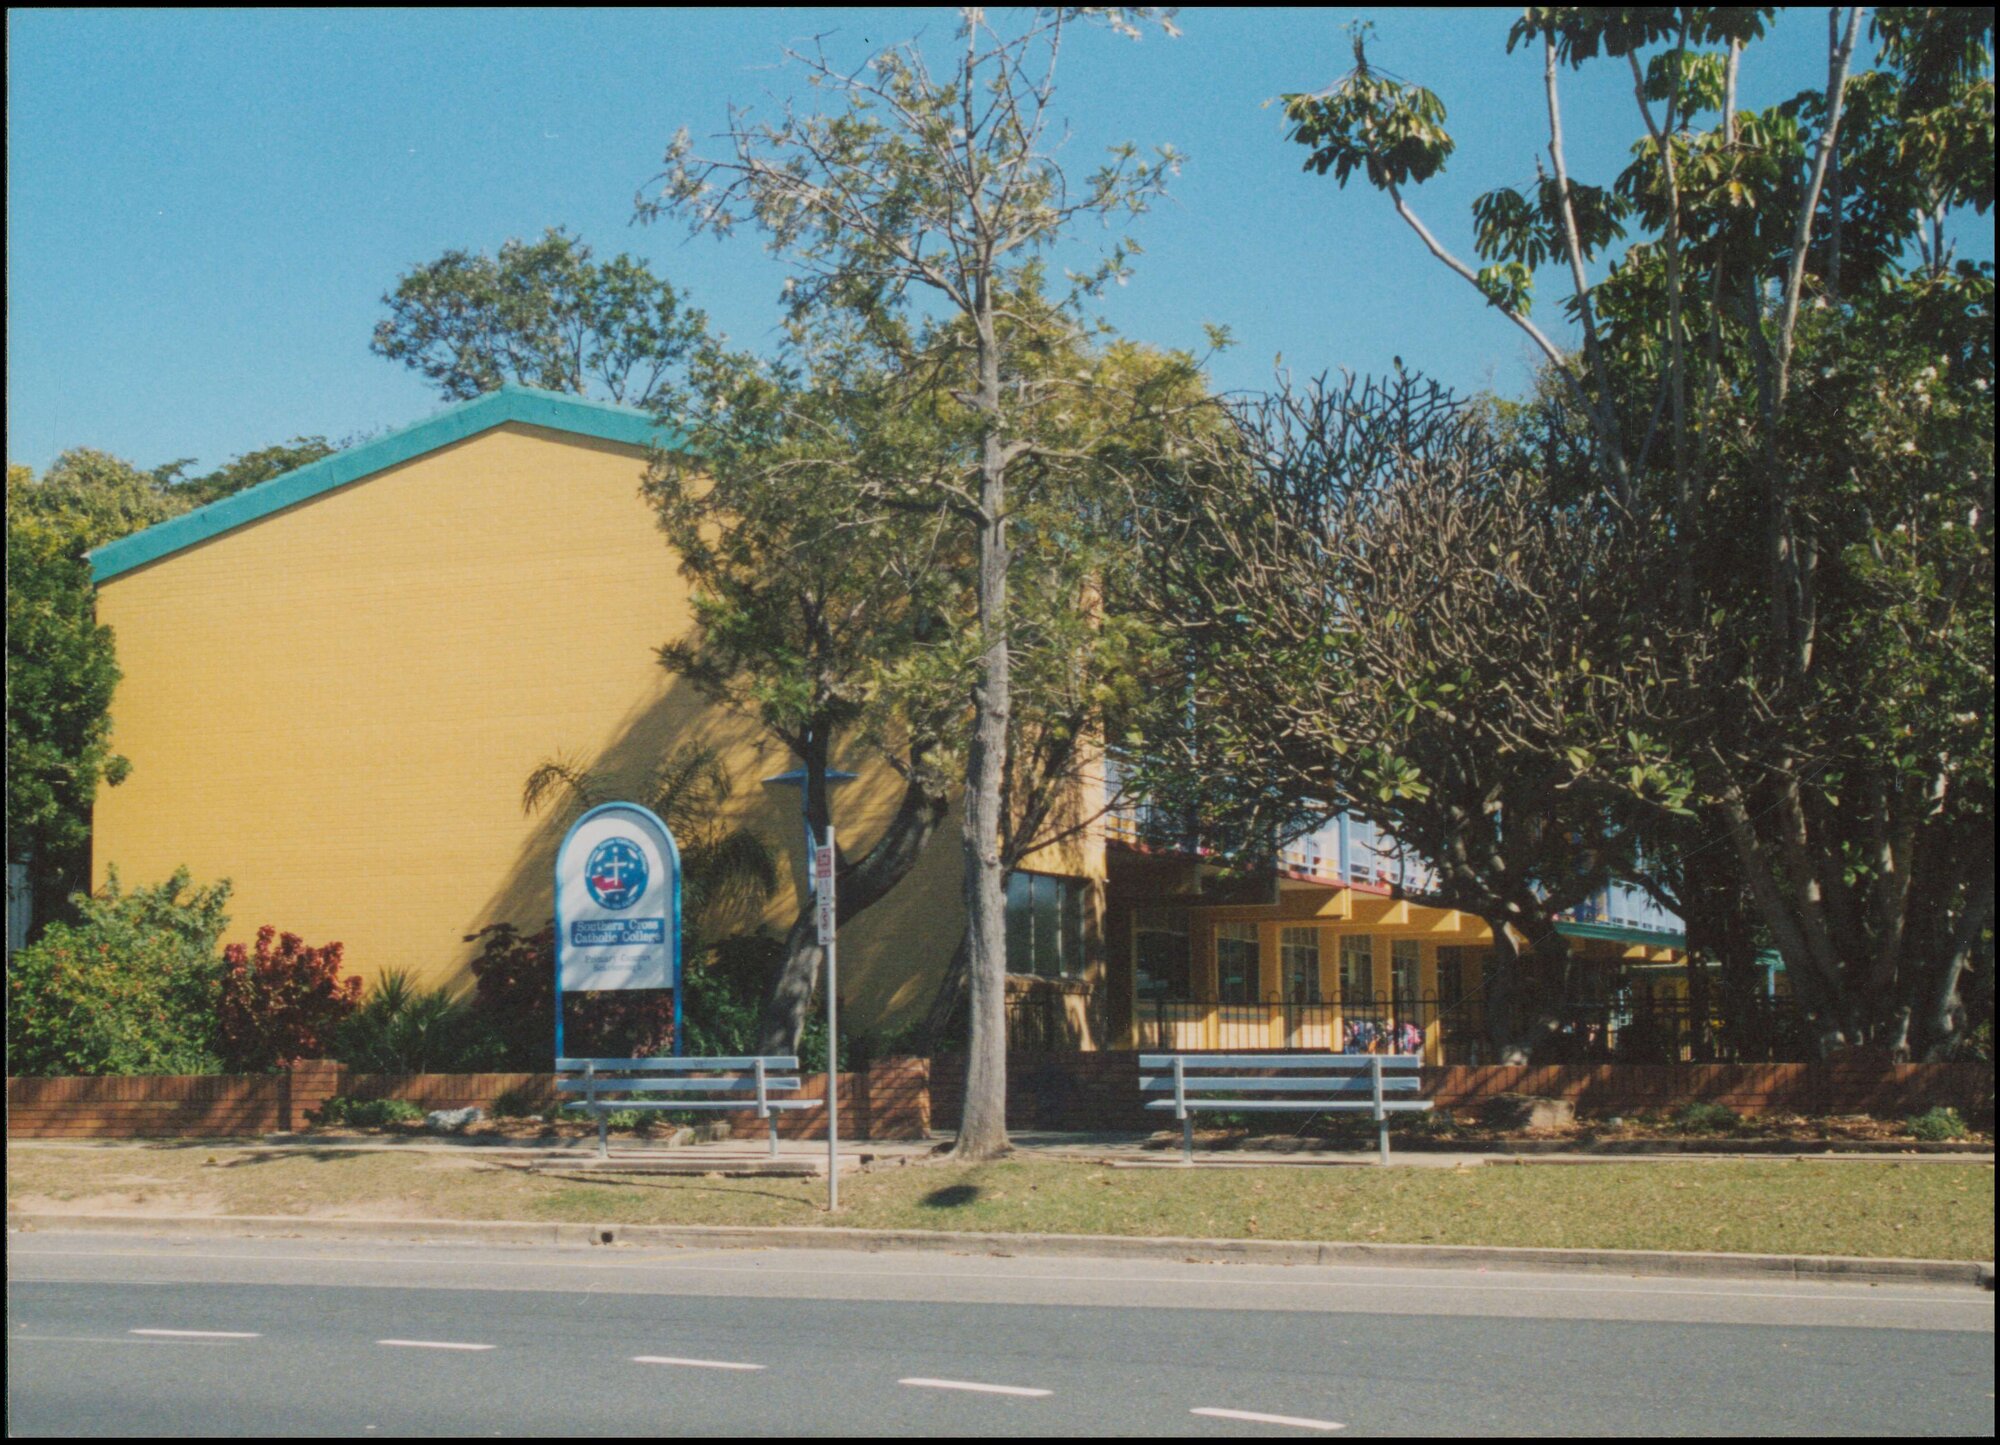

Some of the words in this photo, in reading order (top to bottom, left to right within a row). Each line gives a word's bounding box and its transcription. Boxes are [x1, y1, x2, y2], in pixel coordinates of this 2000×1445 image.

[576, 921, 624, 932] Southern
[628, 919, 659, 930] Cross
[574, 931, 618, 944] Catholic
[622, 930, 661, 943] College
